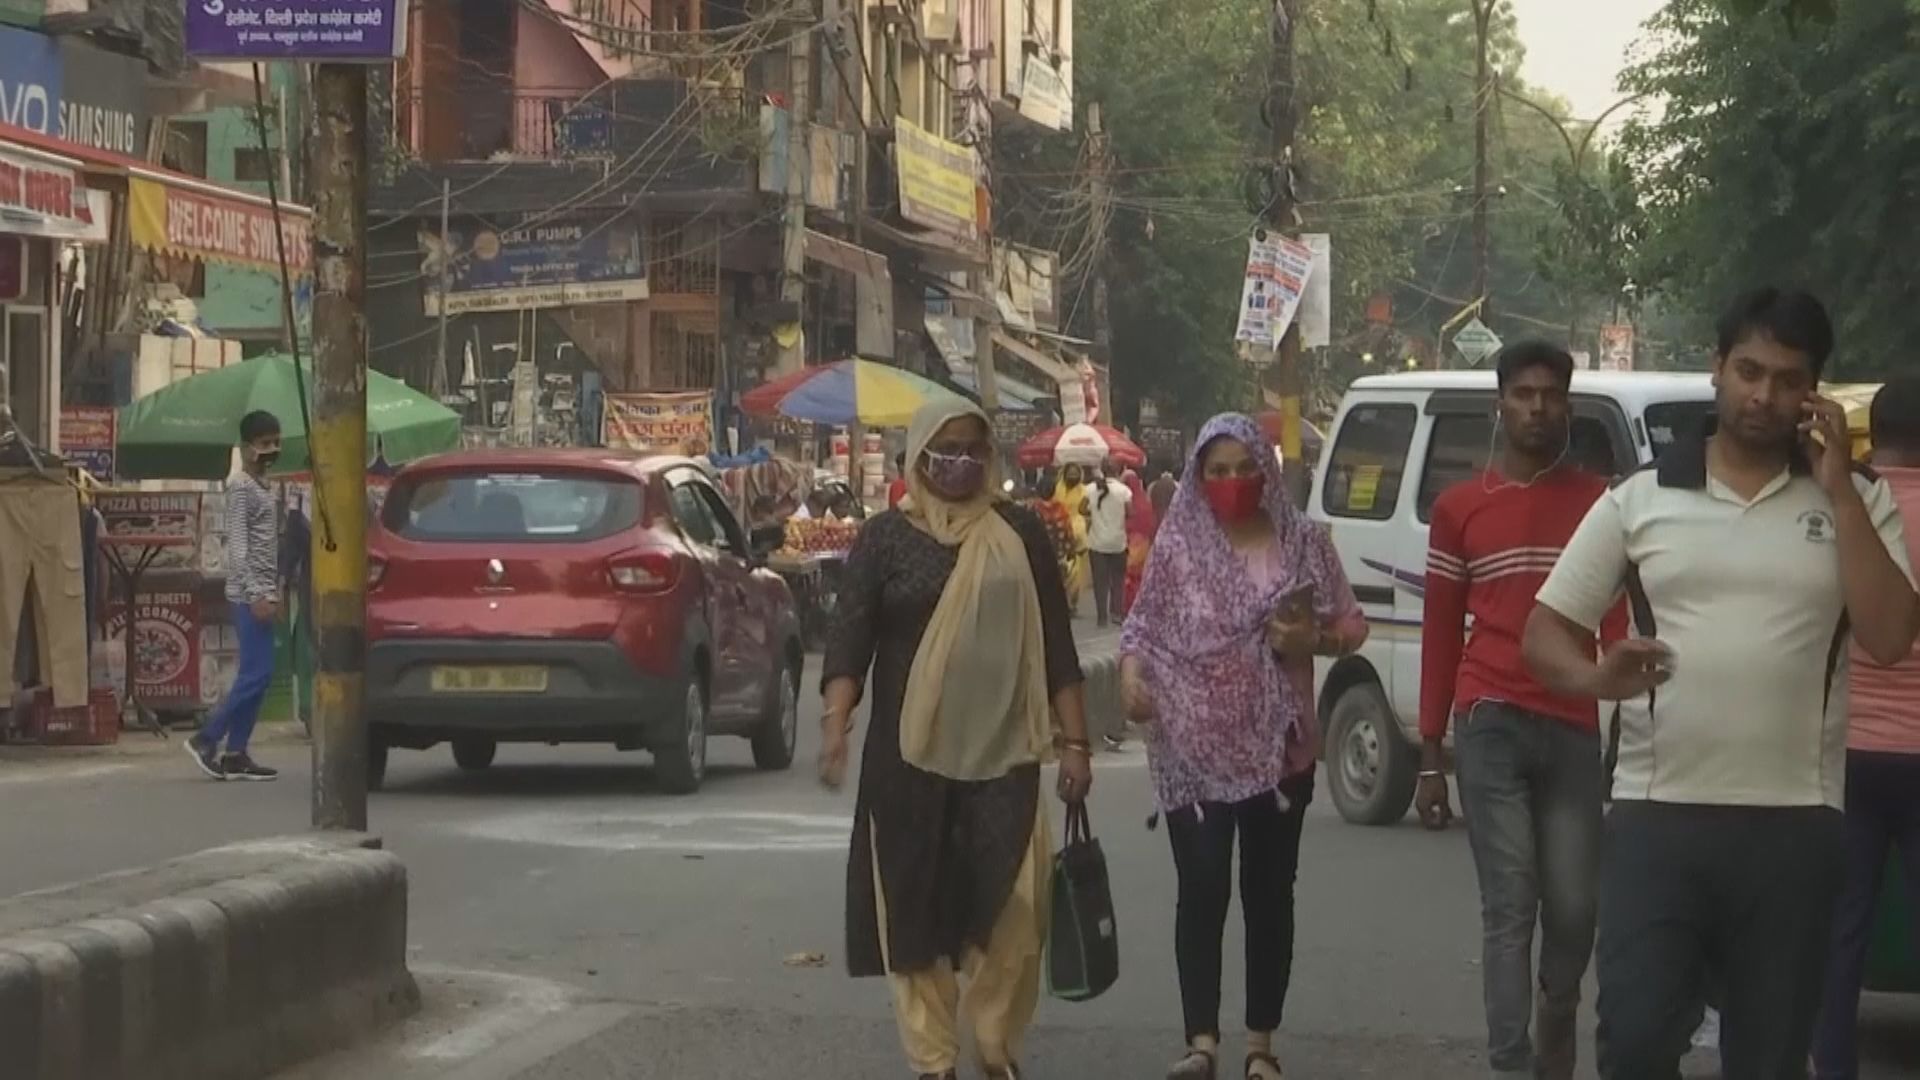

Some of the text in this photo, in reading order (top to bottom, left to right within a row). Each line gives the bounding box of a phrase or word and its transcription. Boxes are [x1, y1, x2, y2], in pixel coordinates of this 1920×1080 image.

[58, 98, 135, 154] SAMSUNG
[168, 198, 246, 256] WELCOME
[536, 226, 582, 242] PUMPS
[142, 606, 192, 632] CORNER
